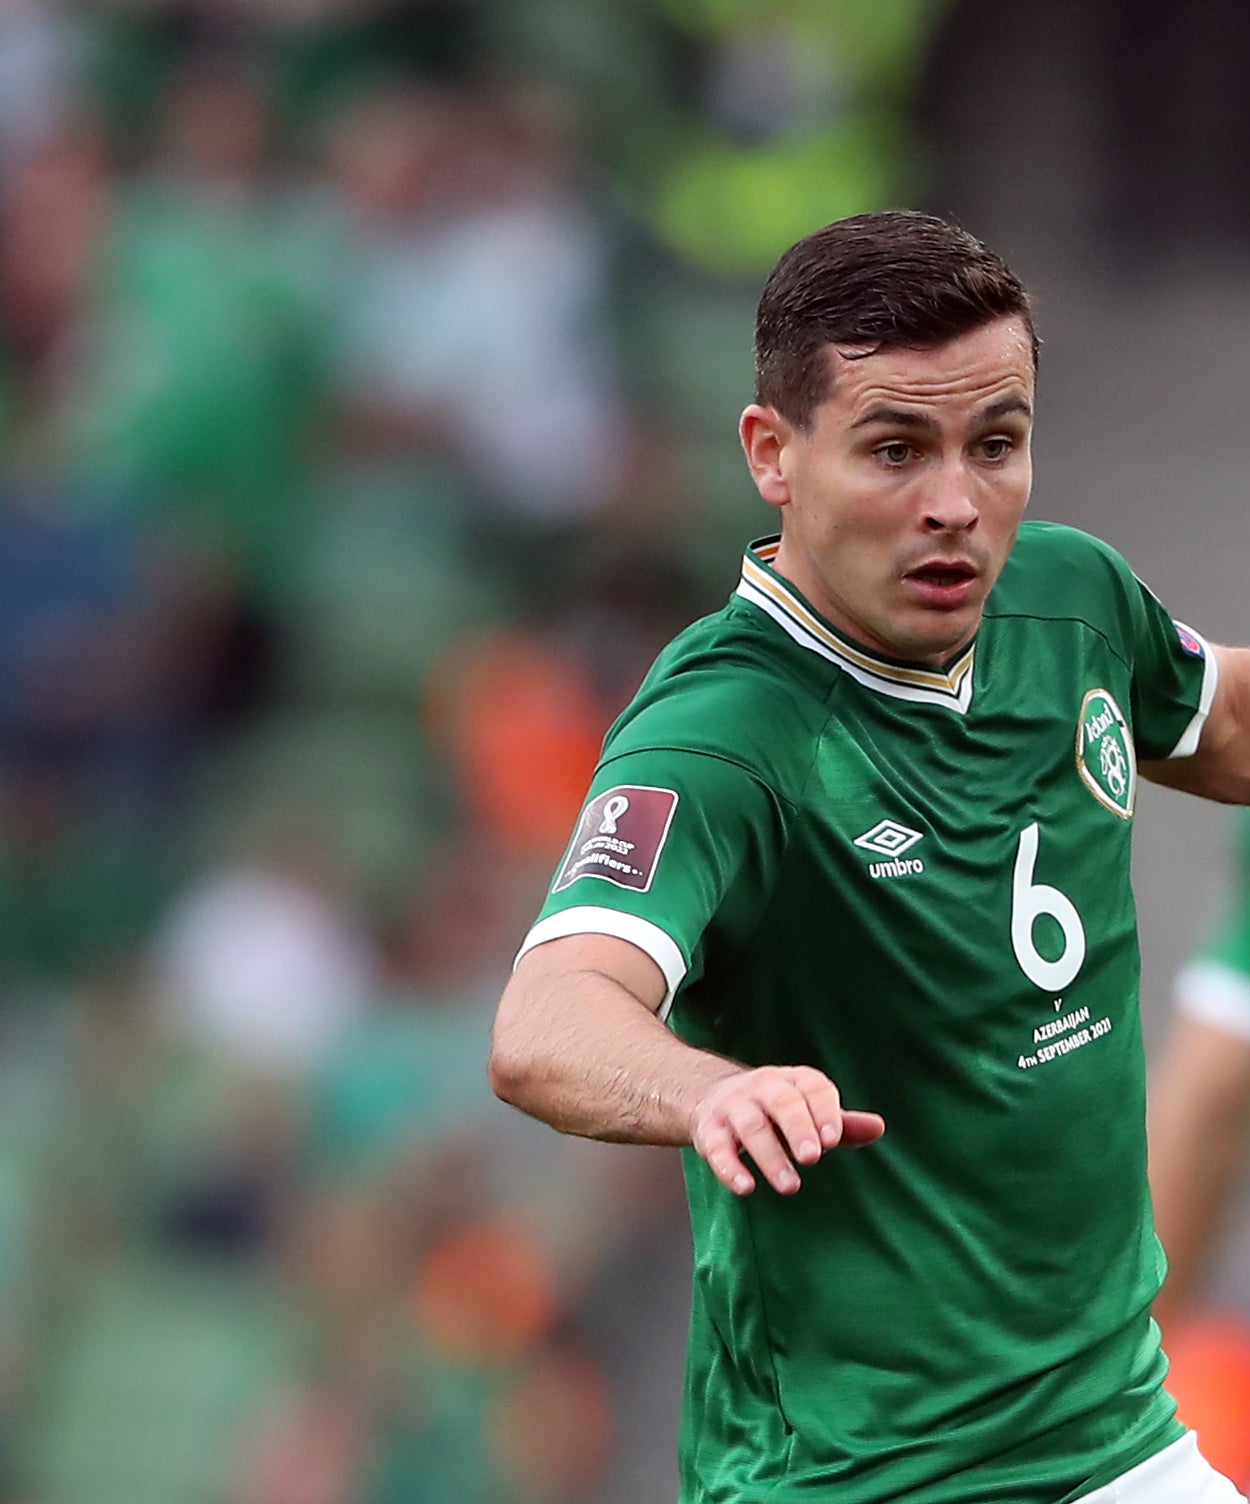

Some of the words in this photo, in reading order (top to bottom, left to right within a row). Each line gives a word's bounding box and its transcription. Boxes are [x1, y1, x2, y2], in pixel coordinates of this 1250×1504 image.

[869, 858, 923, 879] umbro
[1011, 822, 1086, 992] 6
[1033, 1006, 1090, 1043] AZERBAIJAN
[1036, 1029, 1092, 1063] SEPTEMBER
[1089, 1017, 1112, 1040] 2021
